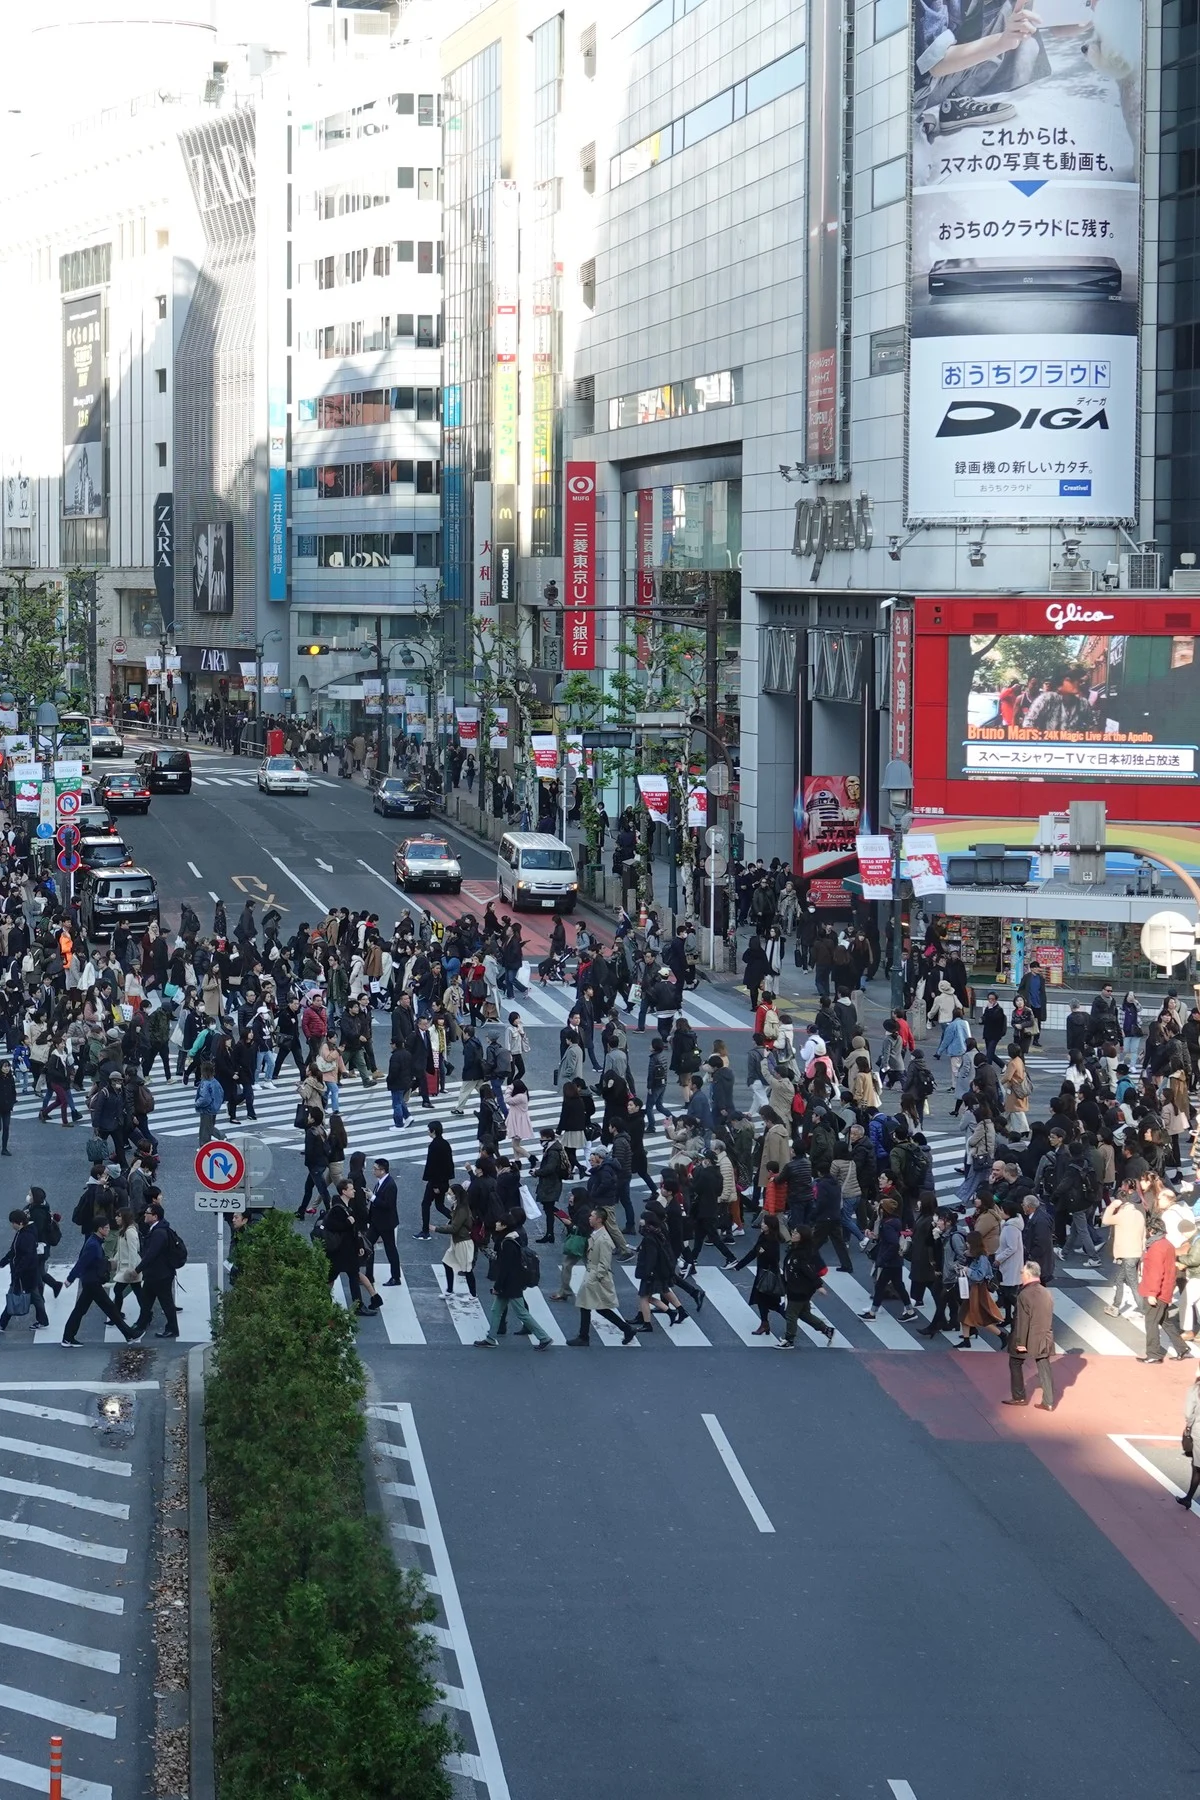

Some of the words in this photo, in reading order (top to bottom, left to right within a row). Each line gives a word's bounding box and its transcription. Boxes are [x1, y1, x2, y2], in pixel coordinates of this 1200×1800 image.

[981, 127, 1076, 147] これからは、
[940, 153, 1114, 174] スマホの写真も動画も、
[938, 218, 1115, 241] おうちのクラウドに残す。
[944, 365, 1107, 386] おうちクラウド
[1076, 397, 1107, 406] ディーガ
[935, 400, 1110, 438] DIGA
[955, 460, 1093, 475] 録画機の新しいカタチ。
[980, 484, 1032, 493] おうちクラウド
[157, 504, 173, 568] ZARA
[272, 493, 283, 574] 三井住友信託銀行
[501, 548, 510, 599] McDonald's
[1045, 603, 1115, 630] Glico
[201, 648, 230, 671] ZARA
[967, 725, 1005, 740] Bruno
[1008, 727, 1042, 741] Mars:
[1044, 731, 1059, 740] 24K
[1060, 731, 1084, 742] Magic
[1085, 731, 1101, 741] Live
[1103, 733, 1111, 741] at
[1112, 732, 1126, 741] the
[1128, 732, 1153, 743] Apollo
[816, 829, 856, 840] STAR
[817, 842, 857, 852] WARS
[198, 1197, 241, 1209] ここから
